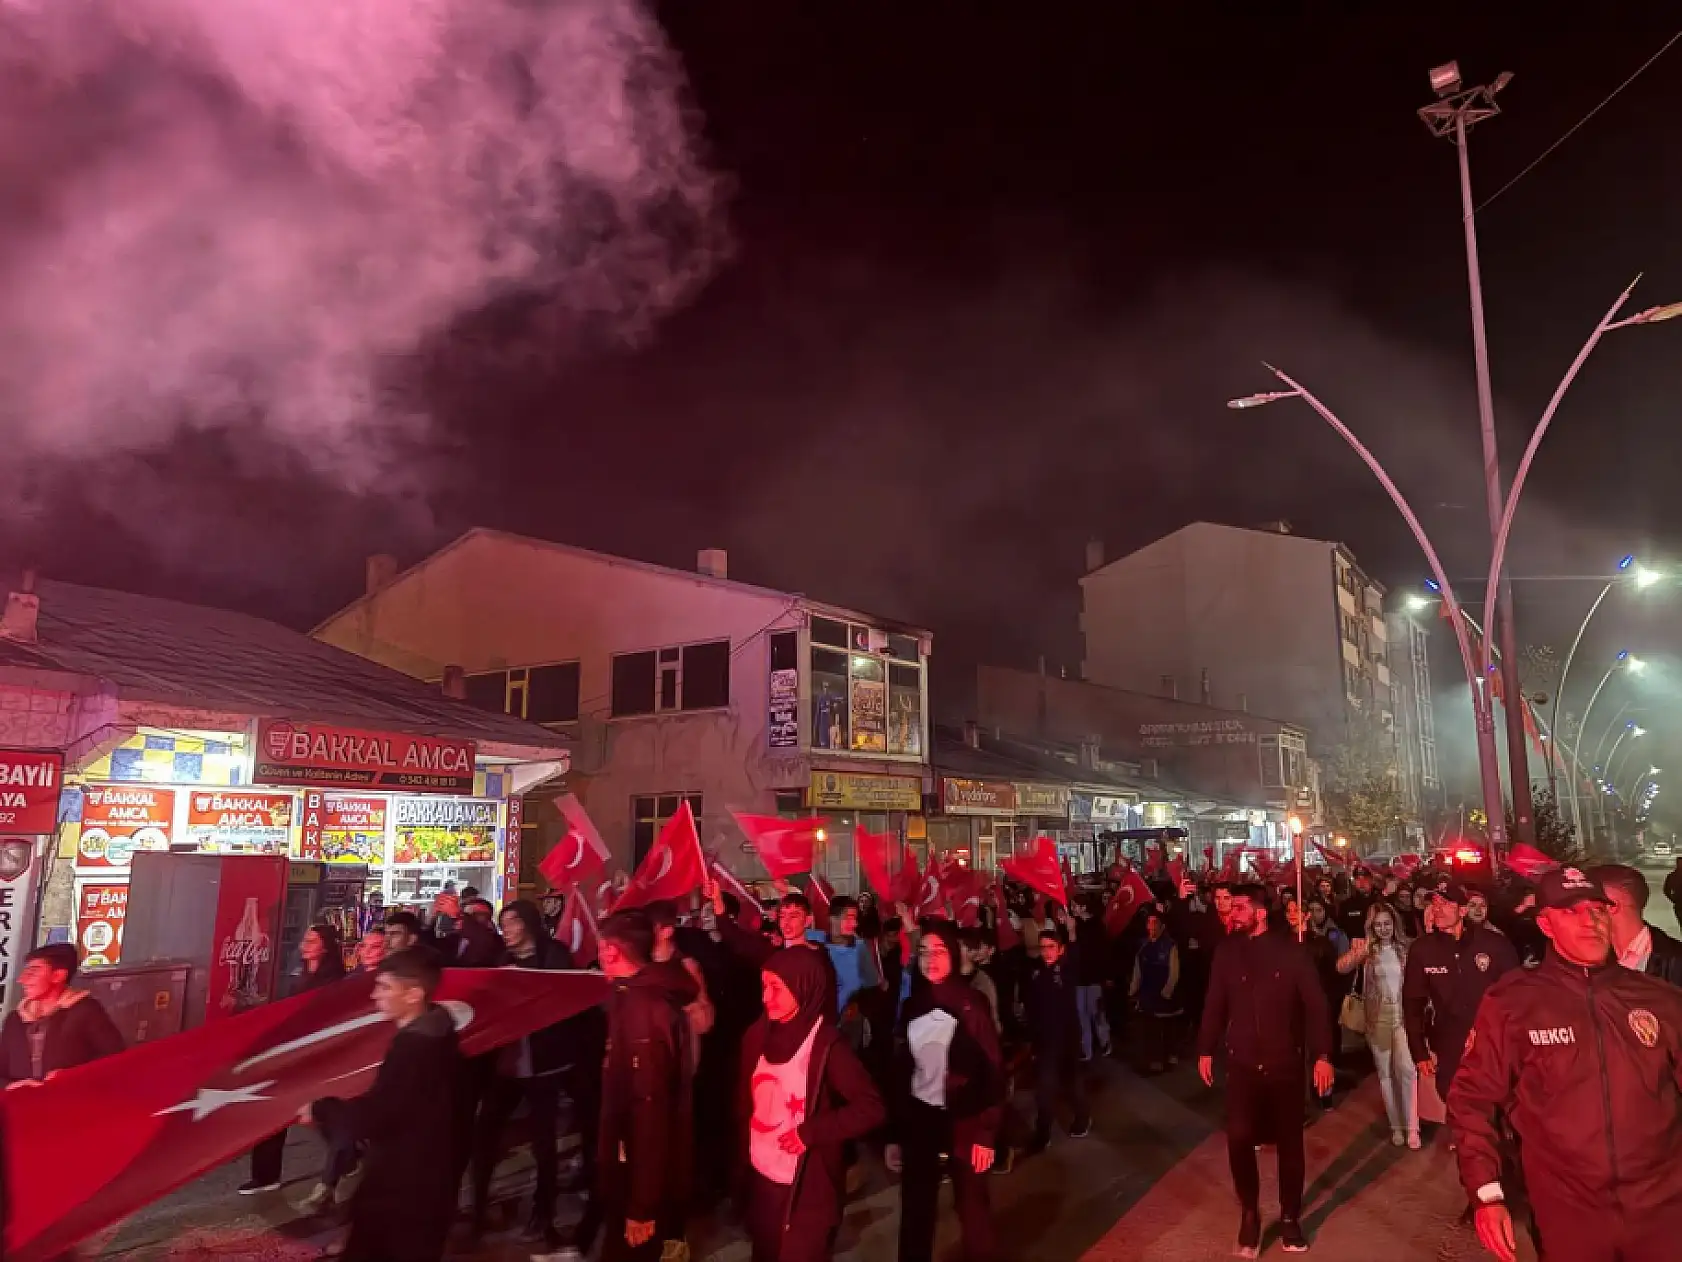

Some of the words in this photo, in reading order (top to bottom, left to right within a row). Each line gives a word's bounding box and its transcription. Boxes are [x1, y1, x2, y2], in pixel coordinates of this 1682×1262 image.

[292, 732, 397, 766] BAKKAL
[402, 741, 470, 772] AMCA
[0, 792, 27, 808] YA
[212, 795, 268, 812] BAKKAL
[218, 812, 263, 825] AMCA
